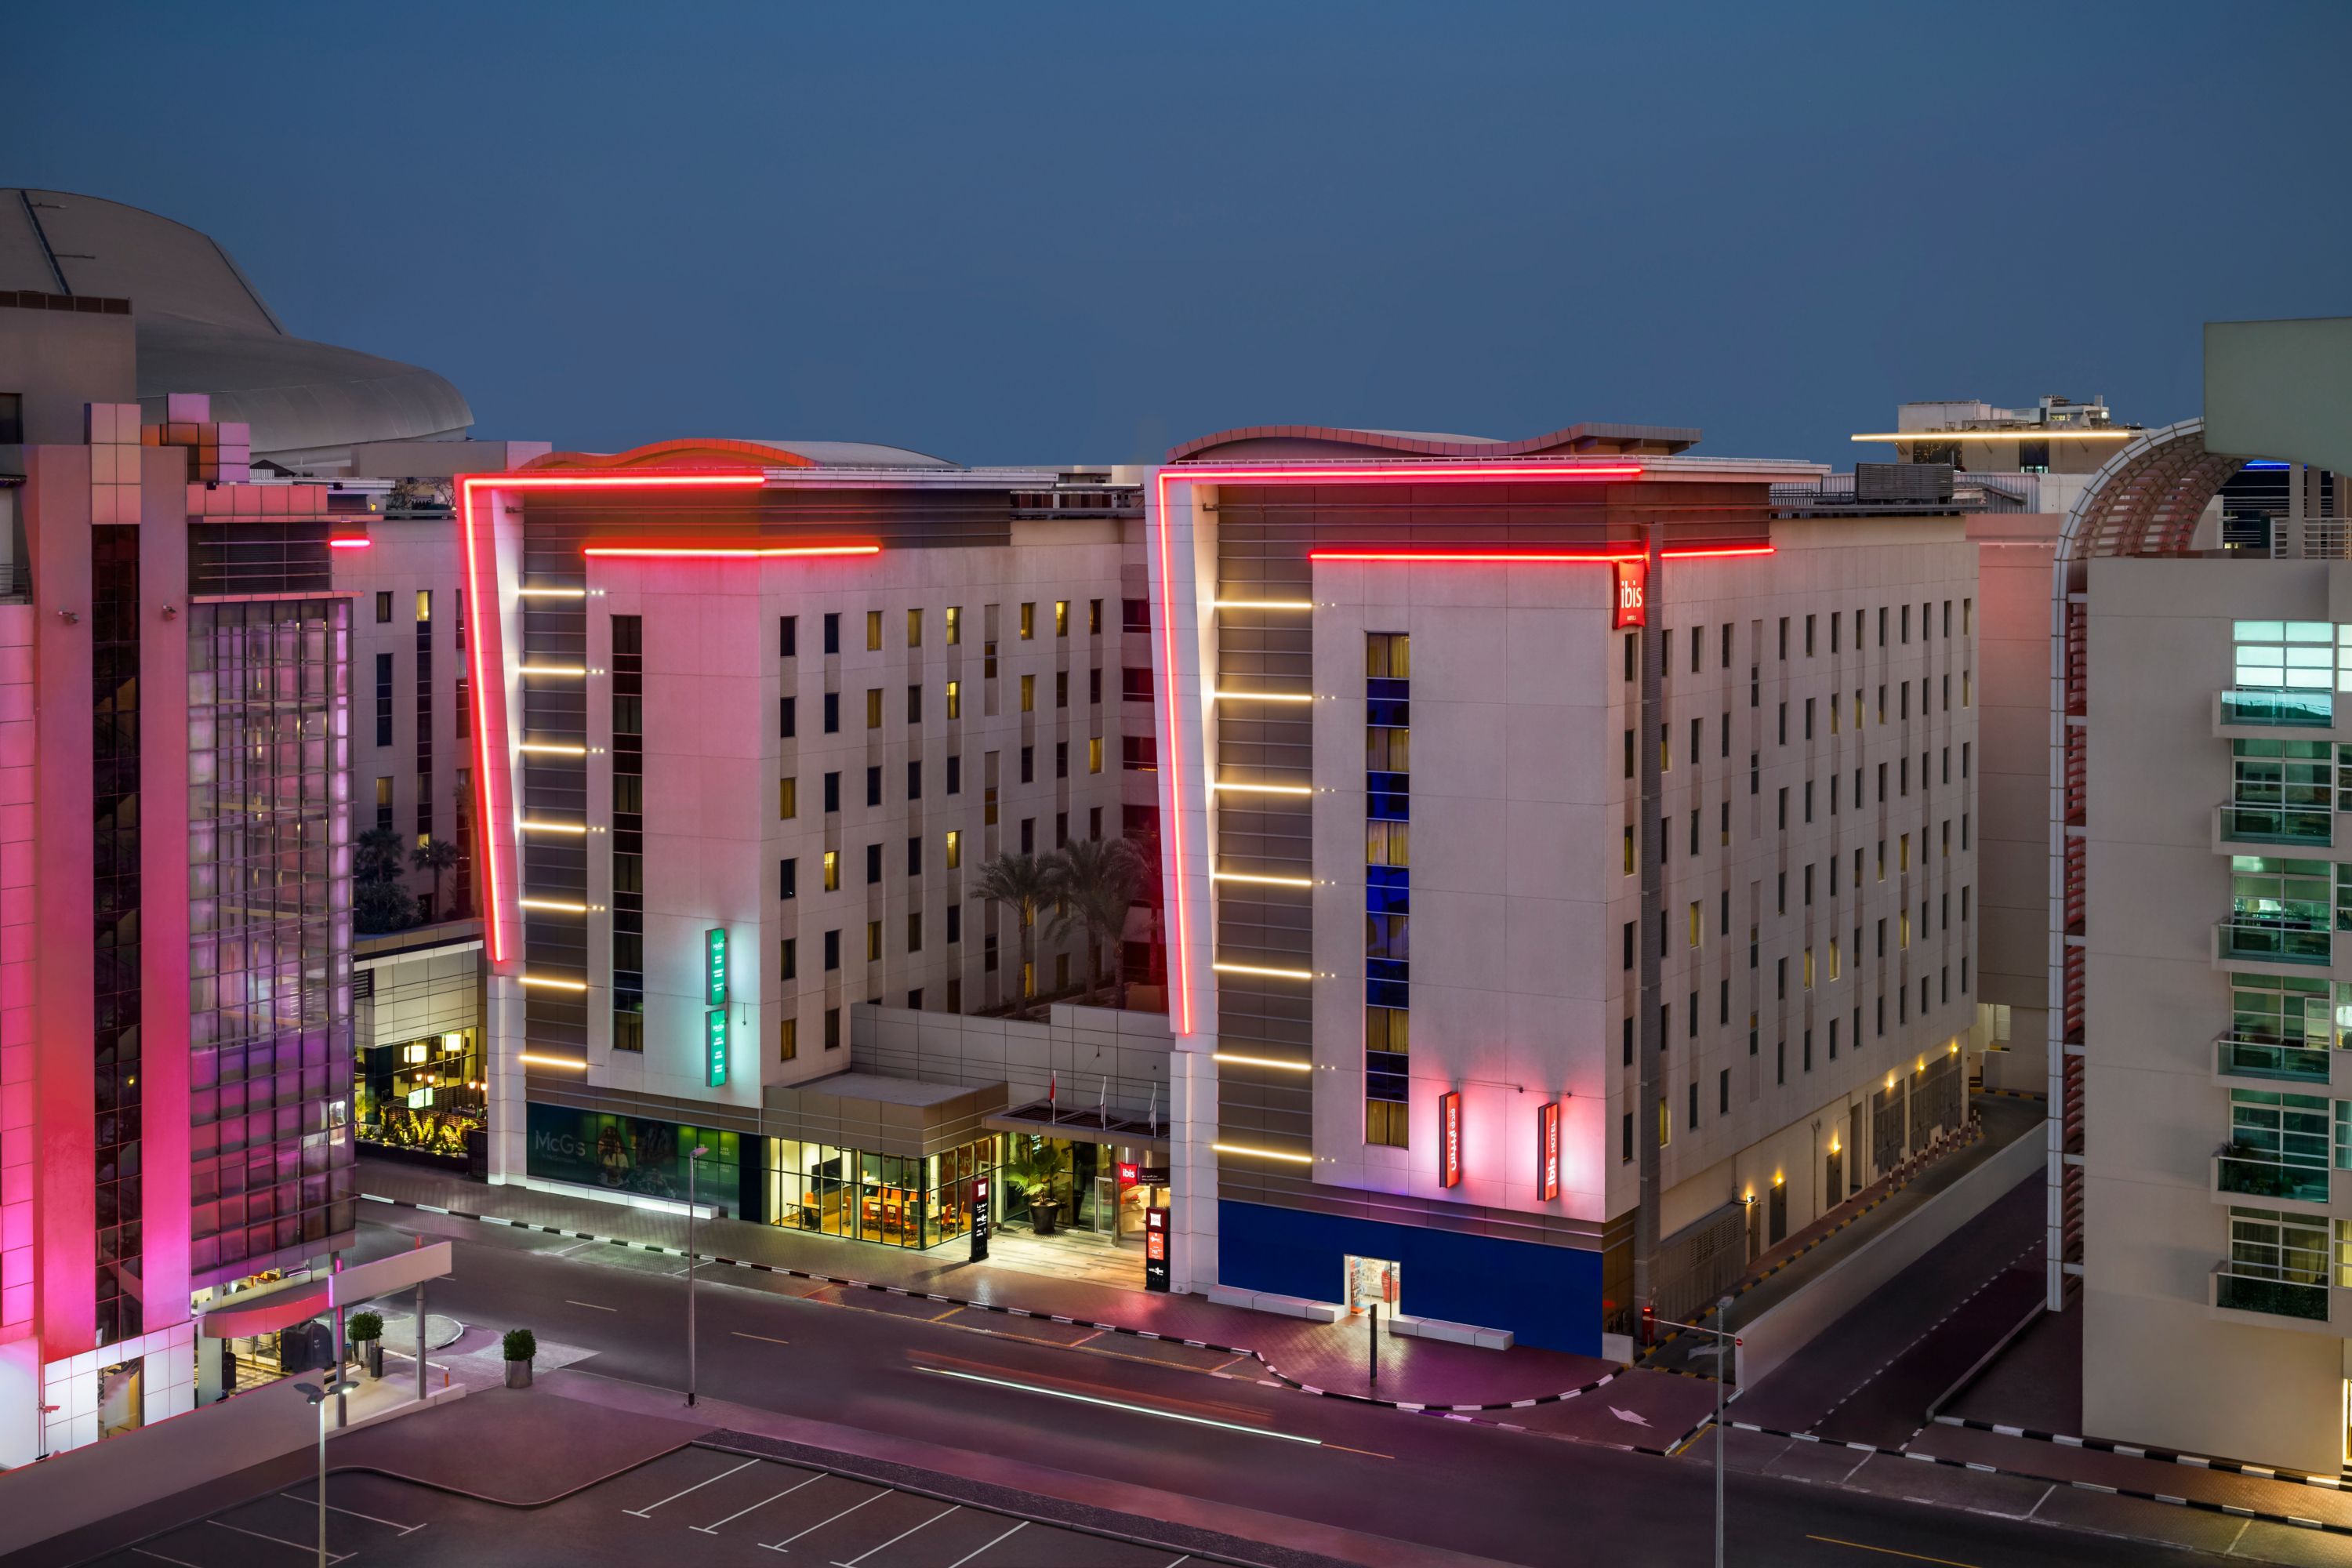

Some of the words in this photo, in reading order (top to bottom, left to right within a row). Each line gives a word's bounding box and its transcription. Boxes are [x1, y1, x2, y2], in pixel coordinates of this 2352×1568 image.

[1621, 580, 1642, 609] ibis
[535, 1130, 586, 1156] McGs
[1123, 1168, 1135, 1178] ibis
